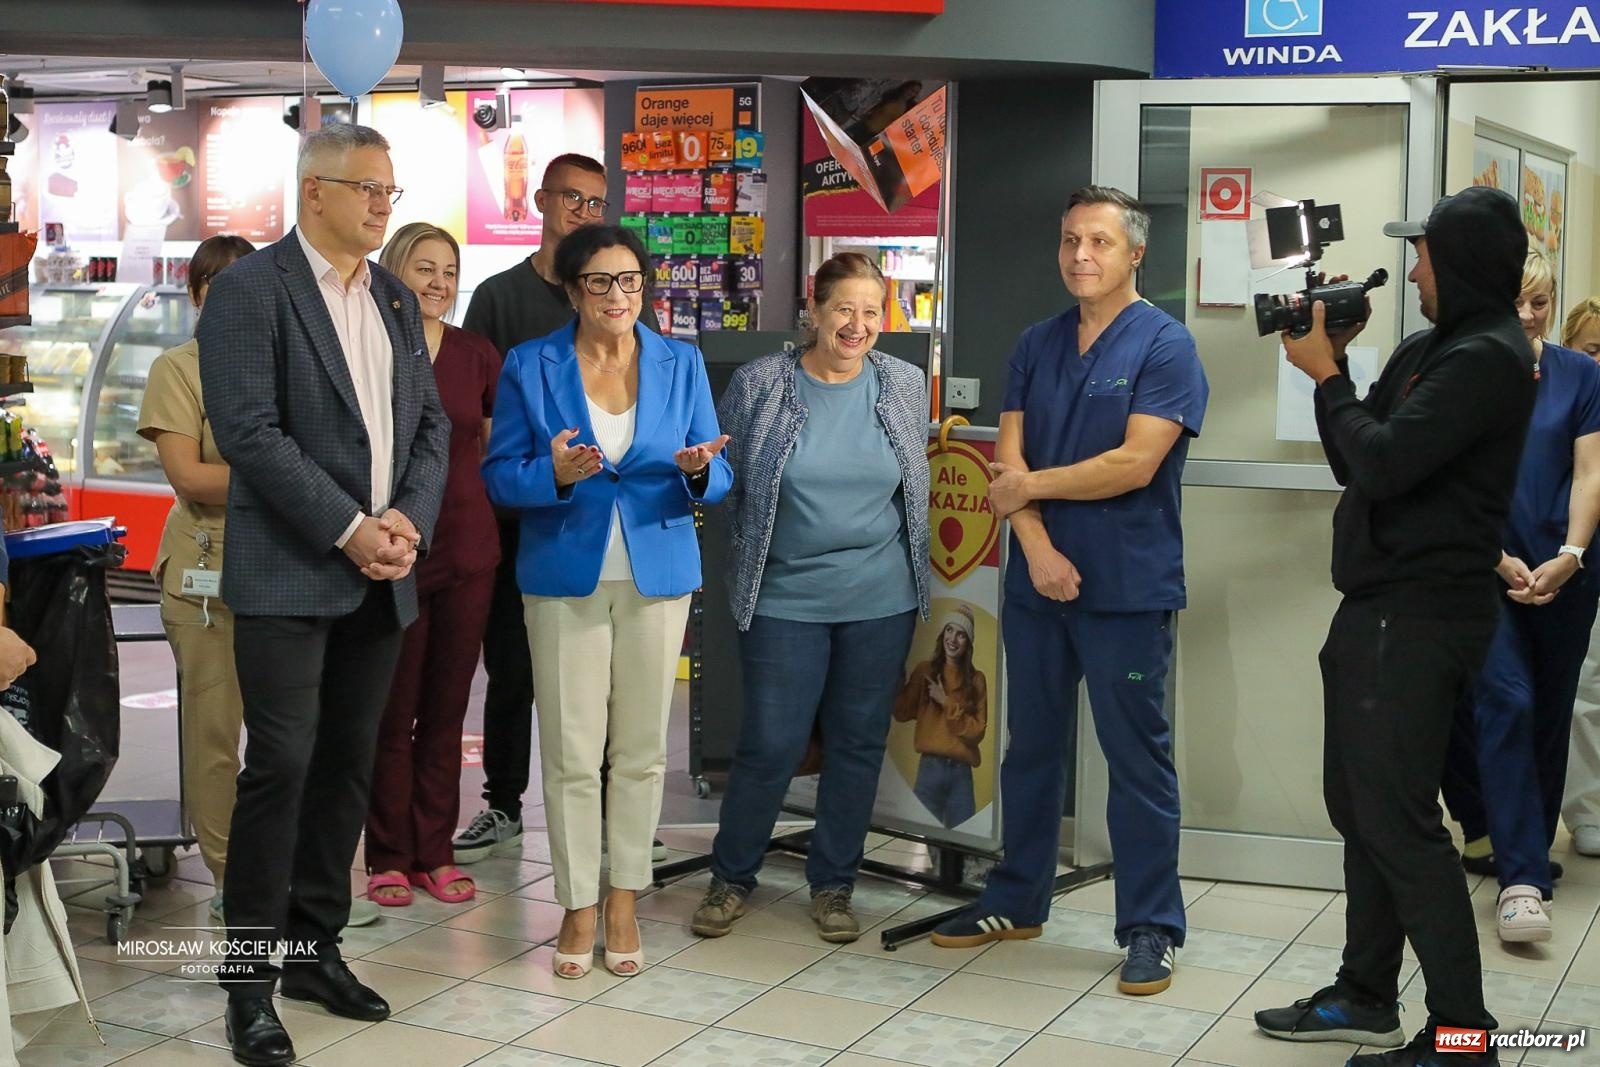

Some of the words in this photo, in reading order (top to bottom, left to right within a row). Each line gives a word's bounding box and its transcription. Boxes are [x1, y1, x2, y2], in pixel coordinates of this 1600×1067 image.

[1404, 7, 1600, 48] ZAKŁA
[1223, 44, 1343, 66] WINDA
[641, 97, 690, 112] Orange
[739, 97, 752, 106] 5G
[640, 113, 668, 129] daje
[672, 112, 714, 128] więcej
[901, 118, 923, 155] starter
[683, 135, 701, 161] 0
[815, 160, 843, 174] OFER
[821, 171, 855, 186] AKTY
[685, 230, 695, 245] 0
[671, 265, 697, 281] 600
[740, 266, 756, 281] 30
[673, 315, 696, 325] 9600
[723, 313, 747, 327] 999
[937, 466, 968, 486] Ale
[928, 491, 993, 514] KAZJA
